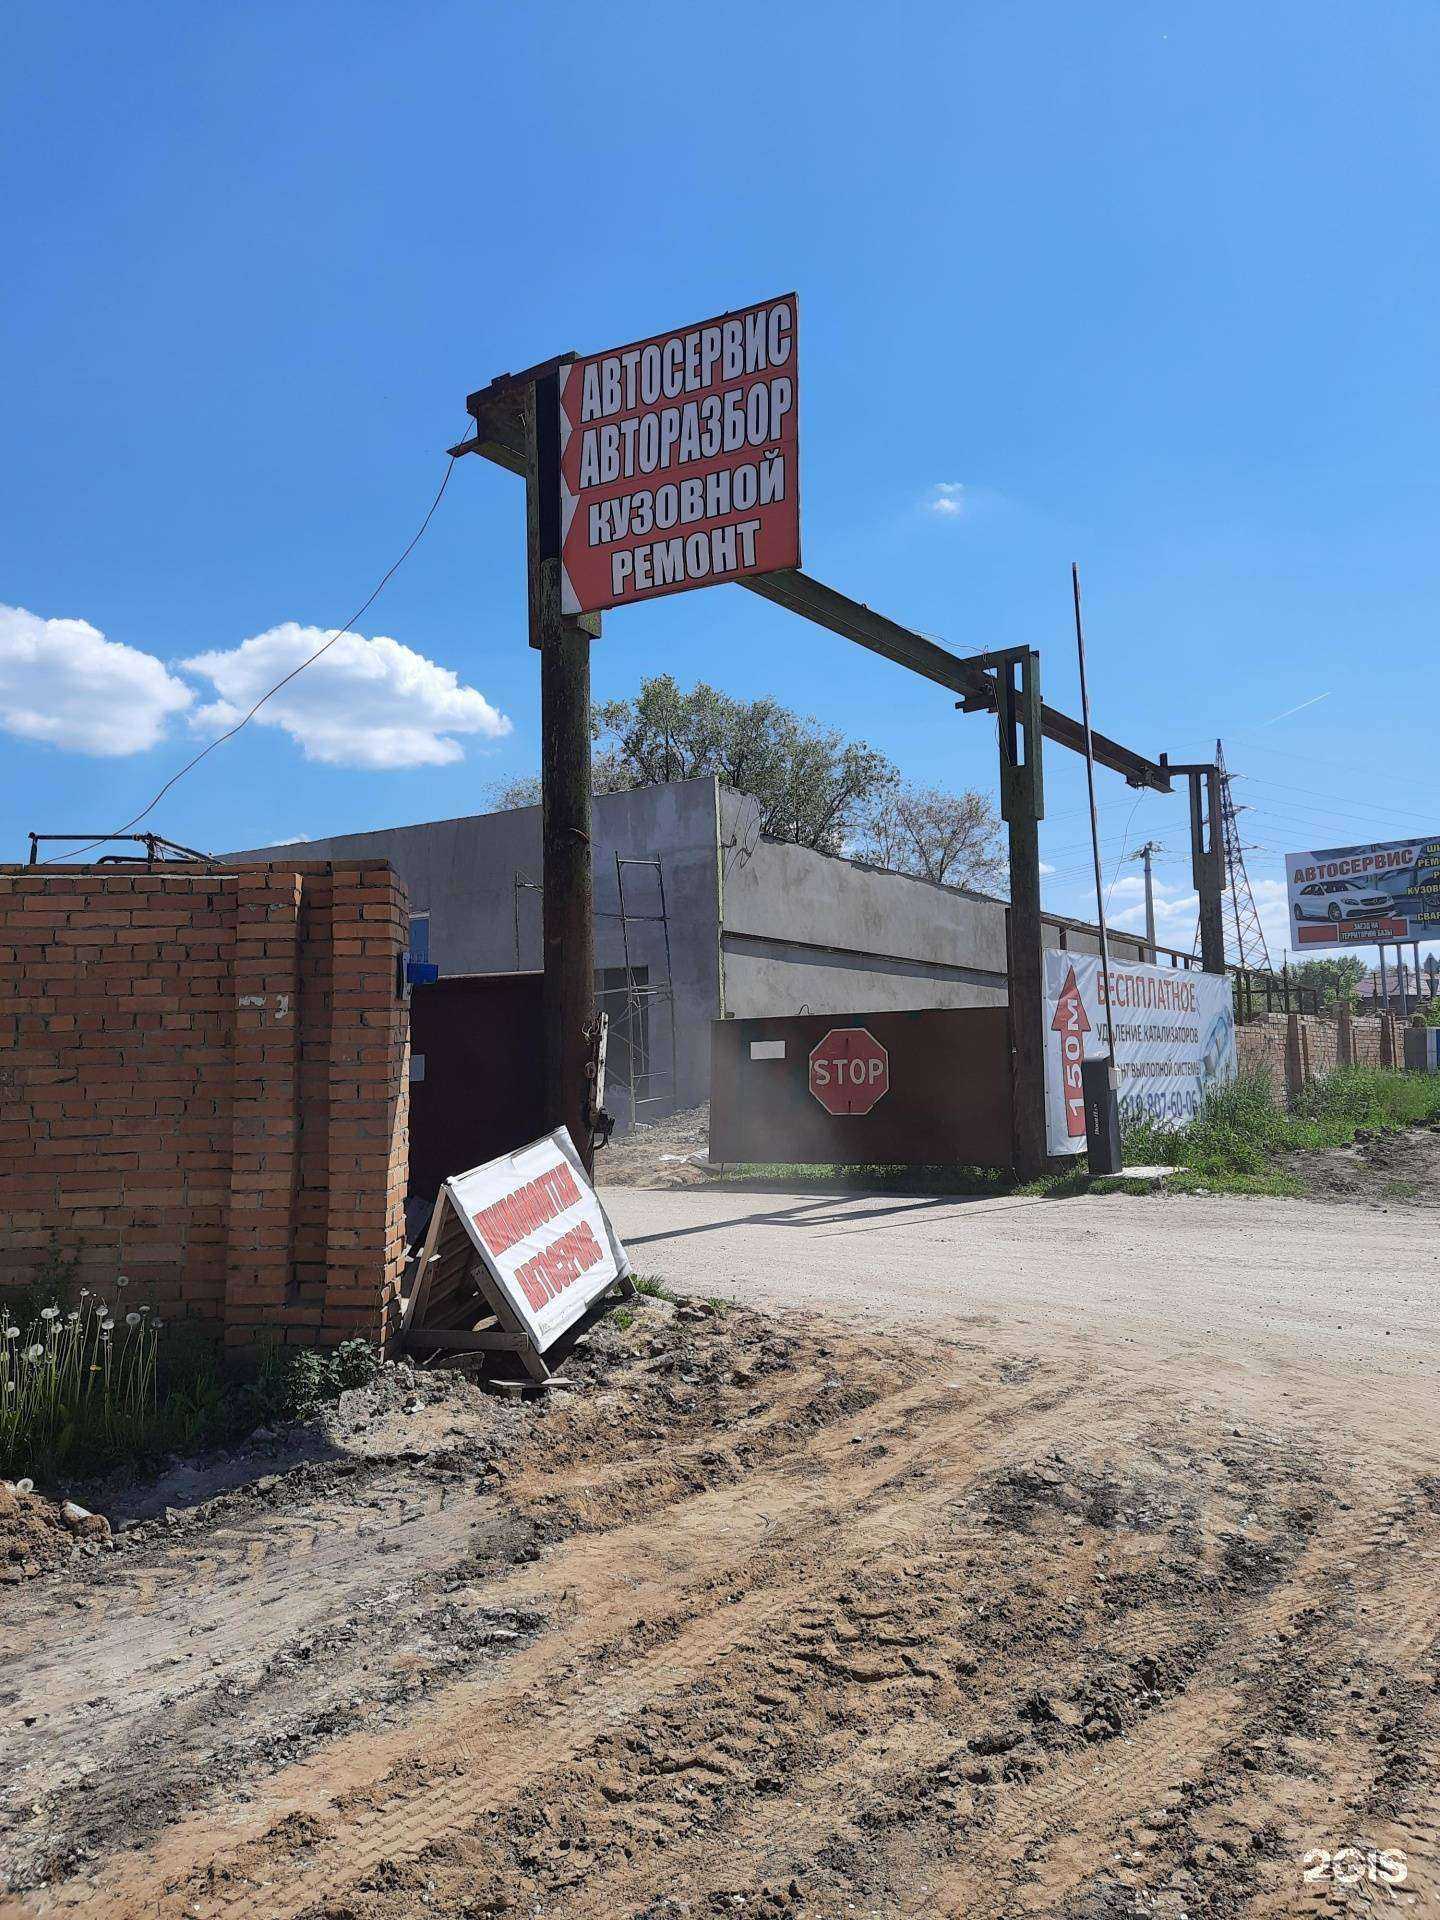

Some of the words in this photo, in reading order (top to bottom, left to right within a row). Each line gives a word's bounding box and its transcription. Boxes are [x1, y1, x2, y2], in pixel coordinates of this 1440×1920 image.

[580, 303, 792, 424] АВТОСЕРВИС
[579, 376, 792, 490] АВТОРАЗБОР
[588, 448, 785, 546] КУЗОВНОЙ
[611, 519, 761, 596] РЕМОНТ
[1294, 849, 1413, 883] АВТОСЕРВИС
[1407, 884, 1440, 895] КУЗОВ
[813, 1059, 884, 1085] STOP
[1144, 1025, 1199, 1043] КАТАЛИЗАТОРОВ
[472, 1162, 582, 1257] ШИНОМОНТАЖ
[514, 1221, 604, 1313] АВТОСЕРВИС
